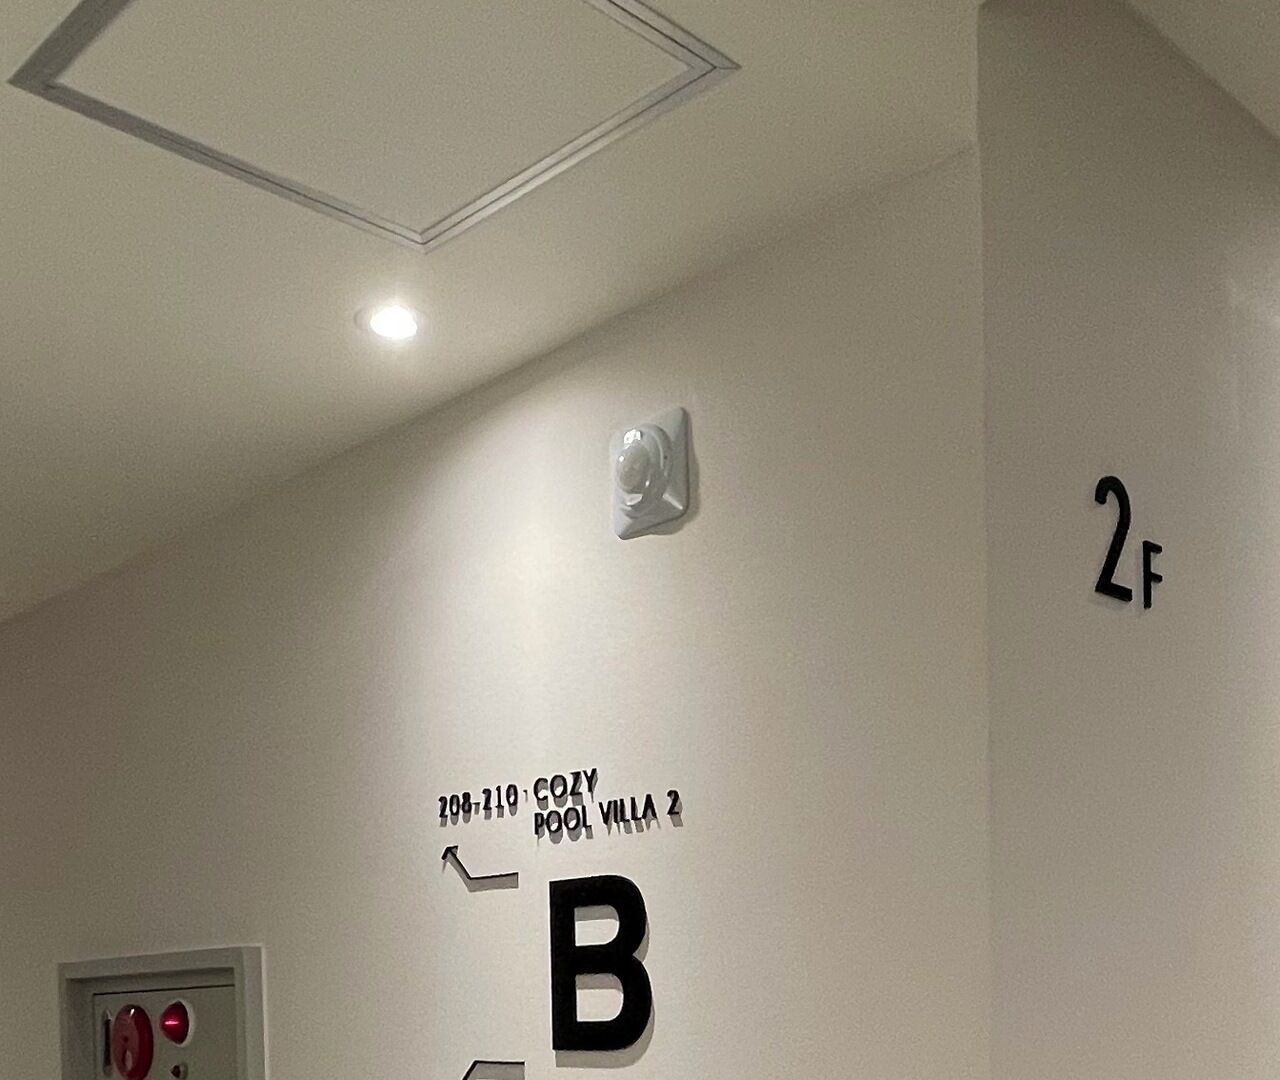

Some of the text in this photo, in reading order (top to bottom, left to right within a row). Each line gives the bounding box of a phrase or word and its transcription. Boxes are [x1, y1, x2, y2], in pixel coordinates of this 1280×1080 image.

[1094, 475, 1163, 610] 2F
[438, 767, 597, 819] 208-210 COZY
[534, 789, 681, 836] POOL VILLA 2
[549, 874, 653, 1051] B
